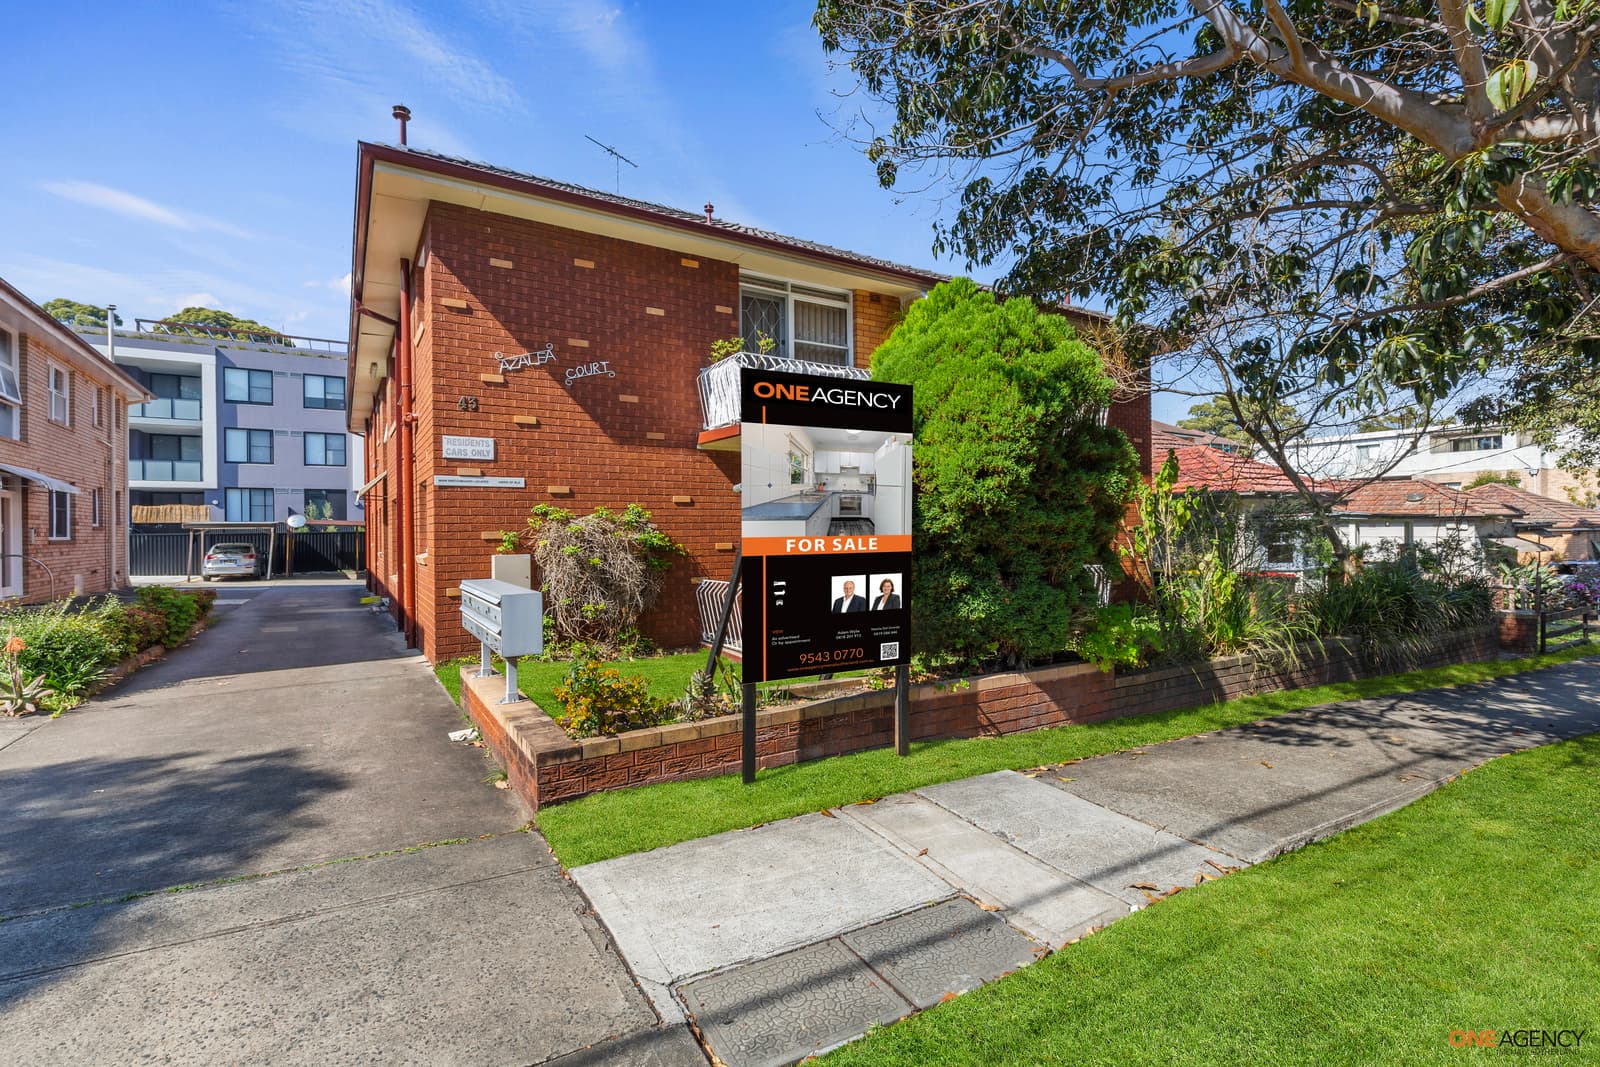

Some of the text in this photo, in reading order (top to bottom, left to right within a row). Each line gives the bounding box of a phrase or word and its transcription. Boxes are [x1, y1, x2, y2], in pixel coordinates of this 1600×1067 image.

[499, 348, 557, 374] AZALEA
[565, 361, 610, 379] COURT
[753, 381, 901, 409] ONE AGENCY
[446, 438, 490, 448] RESIDENTS
[445, 448, 491, 457] CARS ONLY
[786, 537, 878, 552] FOR SALE
[799, 648, 864, 664] 9543 0770
